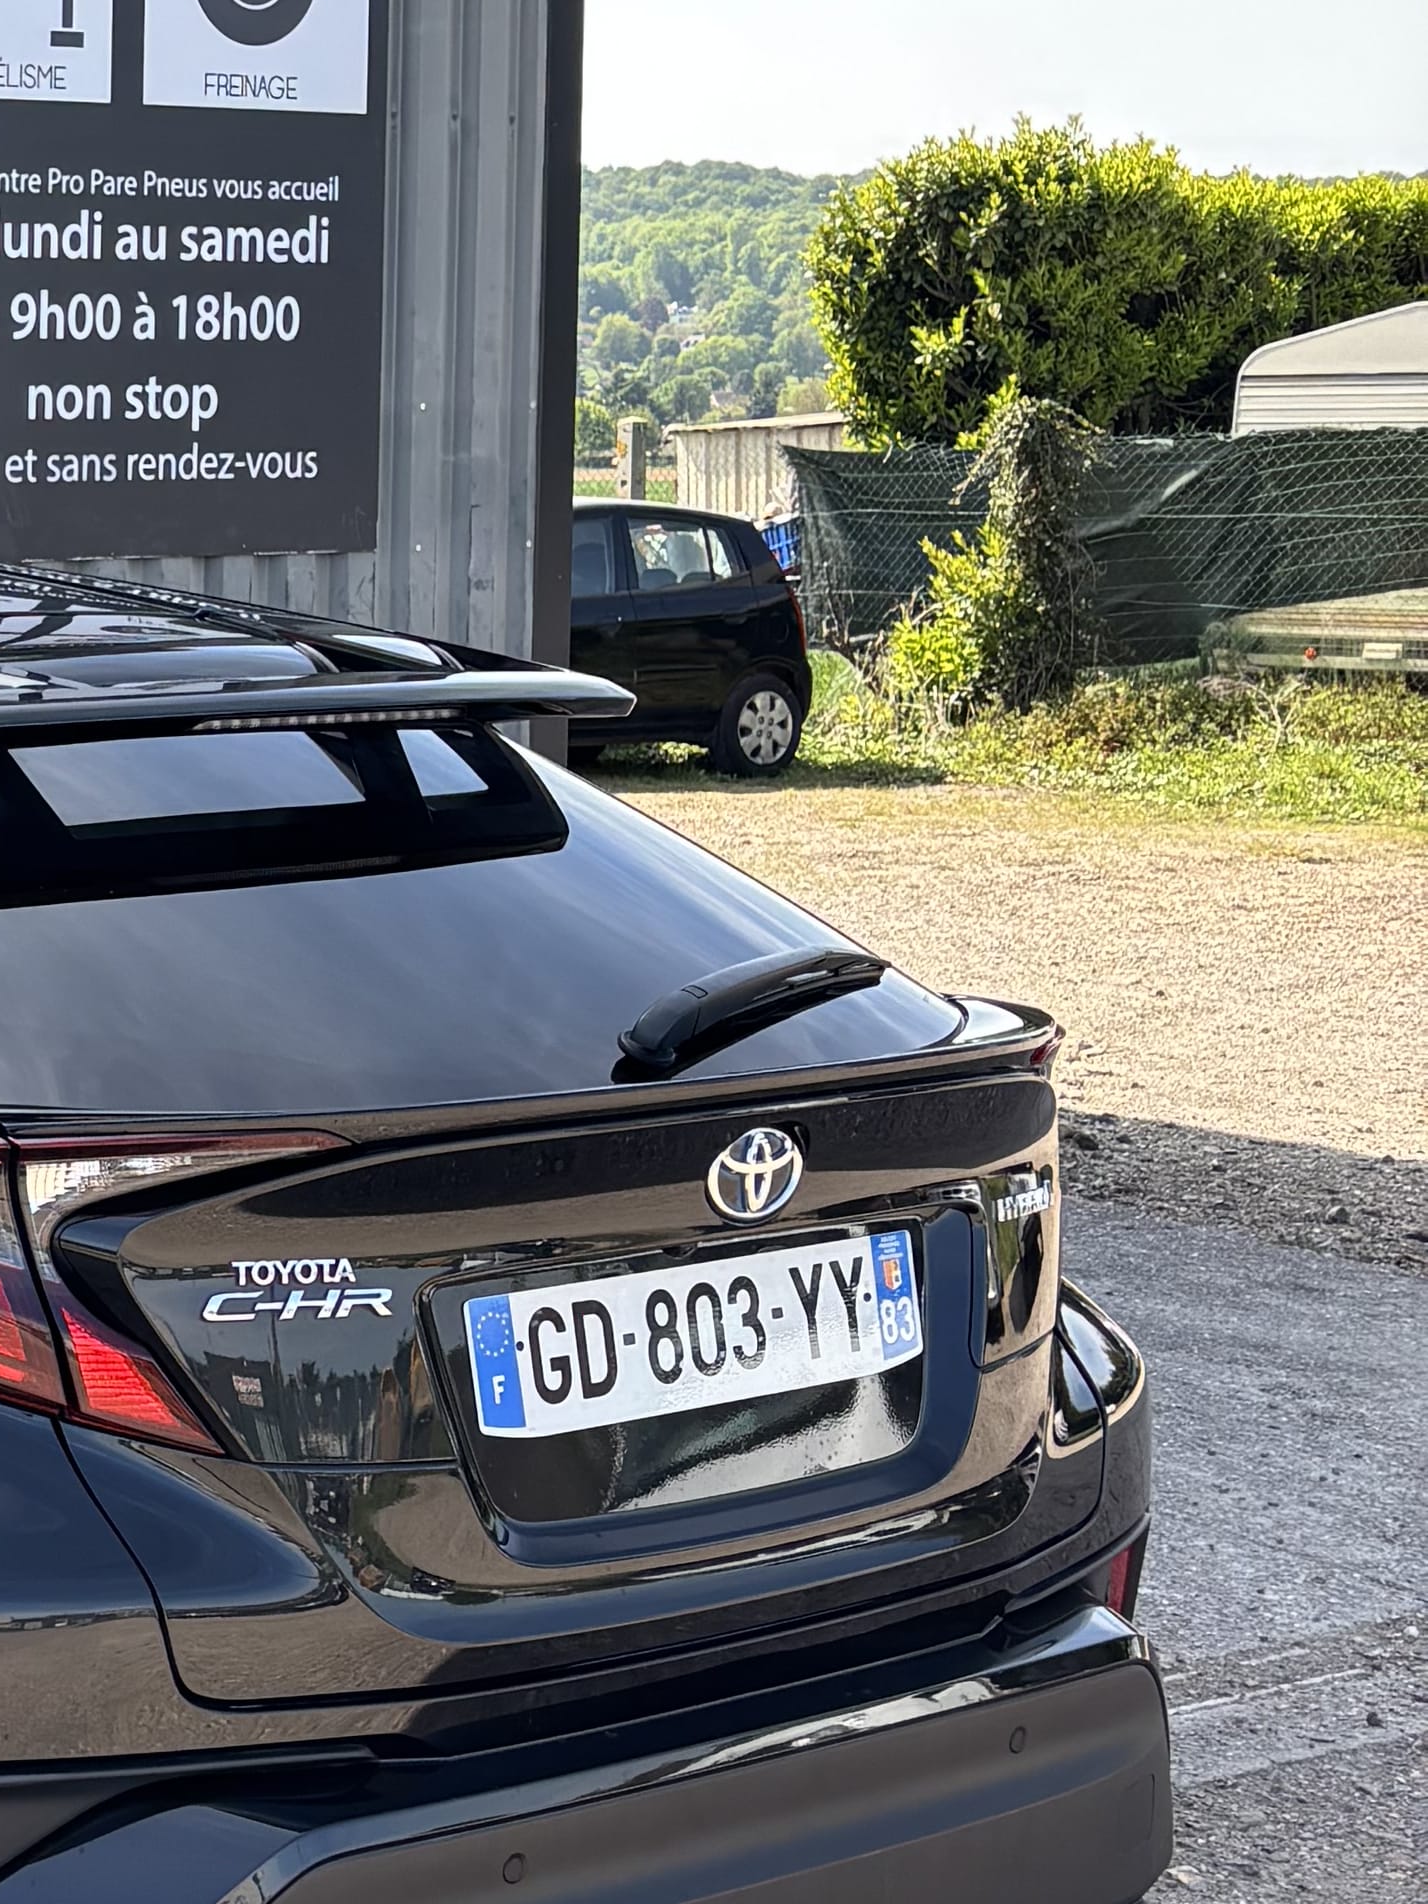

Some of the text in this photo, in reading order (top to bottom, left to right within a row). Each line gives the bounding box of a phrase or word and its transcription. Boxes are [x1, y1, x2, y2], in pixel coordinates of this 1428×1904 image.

[204, 72, 298, 101] FREINAGE
[47, 168, 84, 195] Pro
[90, 169, 137, 196] Pare
[143, 170, 207, 198] Pneus
[213, 180, 263, 200] vous
[268, 175, 339, 202] accueil
[115, 224, 167, 262] au
[180, 215, 330, 264] samedi
[10, 289, 122, 341] 9h00
[132, 291, 156, 341] à
[172, 291, 301, 341] 18h00
[27, 376, 219, 432] non stop
[4, 448, 37, 484] et
[46, 453, 117, 484] sans
[126, 442, 318, 482] rendez-vous
[231, 1258, 357, 1286] TOYOTA
[202, 1288, 393, 1322] C-HR
[880, 1296, 915, 1344] 83
[528, 1256, 863, 1404] GD-803-YY
[492, 1375, 505, 1404] F
